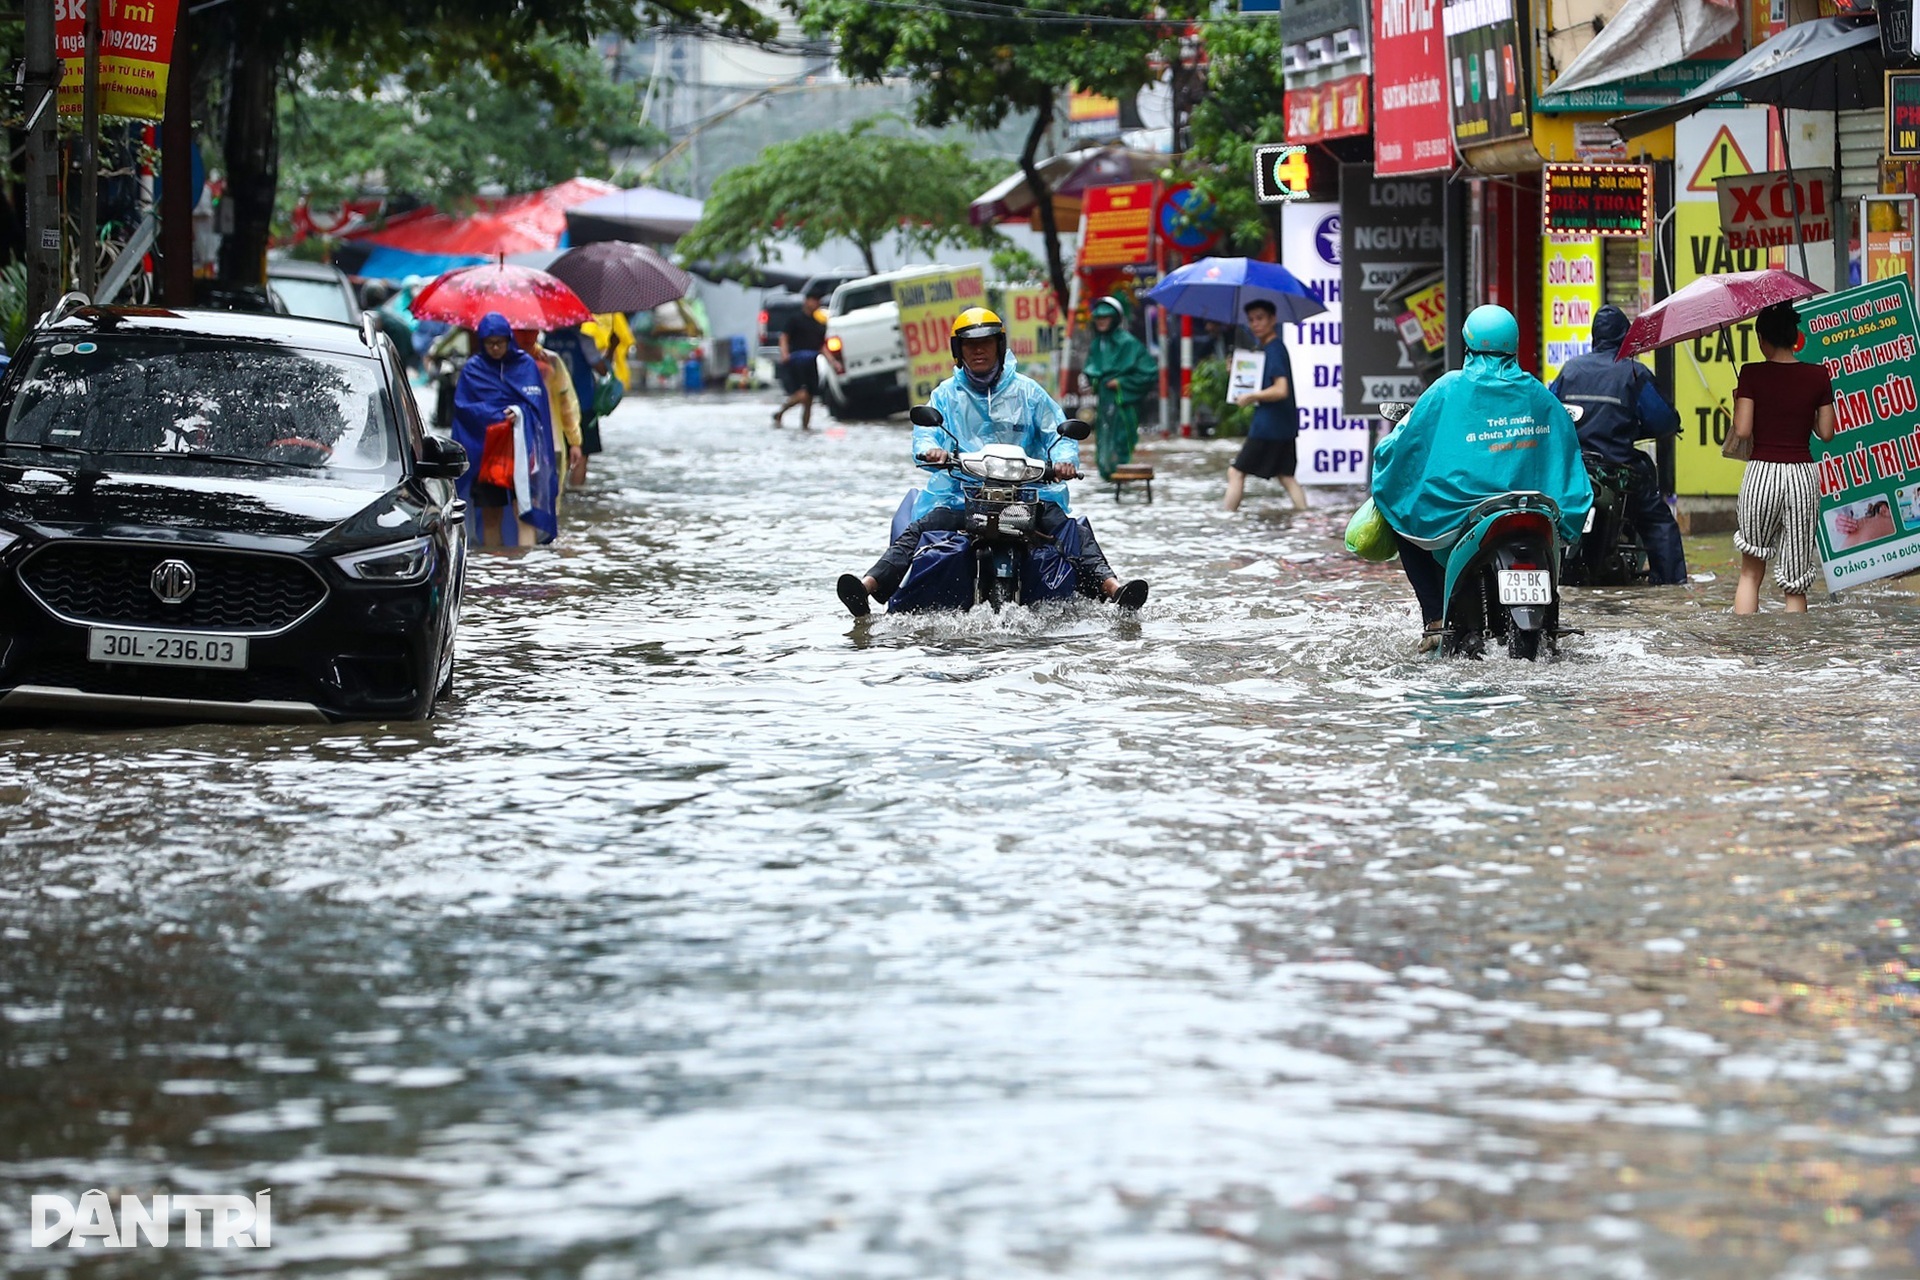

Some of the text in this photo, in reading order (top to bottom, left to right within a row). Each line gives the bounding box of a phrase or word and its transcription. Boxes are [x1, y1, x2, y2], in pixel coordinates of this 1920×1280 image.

[62, 32, 85, 53] ngà
[59, 103, 83, 113] 0868
[1897, 106, 1920, 126] PH
[1900, 131, 1916, 148] IN
[1552, 175, 1571, 188] MUA
[1728, 175, 1825, 224] XÔI
[1728, 225, 1794, 250] BÁNH
[1801, 218, 1830, 243] MÌ
[1311, 279, 1341, 302] NH
[1416, 286, 1445, 322] XÔ
[1808, 313, 1841, 334] ĐÔNG
[1841, 309, 1852, 325] Y
[1874, 293, 1902, 314] VINH
[1297, 322, 1341, 345] THU
[1831, 316, 1898, 344] 0972.856.308
[1823, 333, 1917, 381] ÓP BẤM HUYỆT
[1314, 366, 1342, 392] ĐẠ
[1833, 373, 1918, 434] ÂM CỨU
[1487, 415, 1535, 427] Trời mưa,
[1696, 398, 1731, 446] TÓ
[1466, 432, 1477, 443] đi
[1478, 430, 1504, 441] chưa
[1505, 426, 1535, 438] XANH
[1314, 450, 1364, 473] GPP
[1818, 424, 1920, 502] VẬT LÝ TRỊ LI
[1844, 560, 1868, 575] TẦNG
[1869, 557, 1876, 567] 3
[1881, 551, 1898, 563] 104
[156, 563, 191, 598] MG
[1507, 573, 1542, 587] 29-BK
[1503, 588, 1547, 602] 015.61
[103, 635, 234, 662] 30L-236.03
